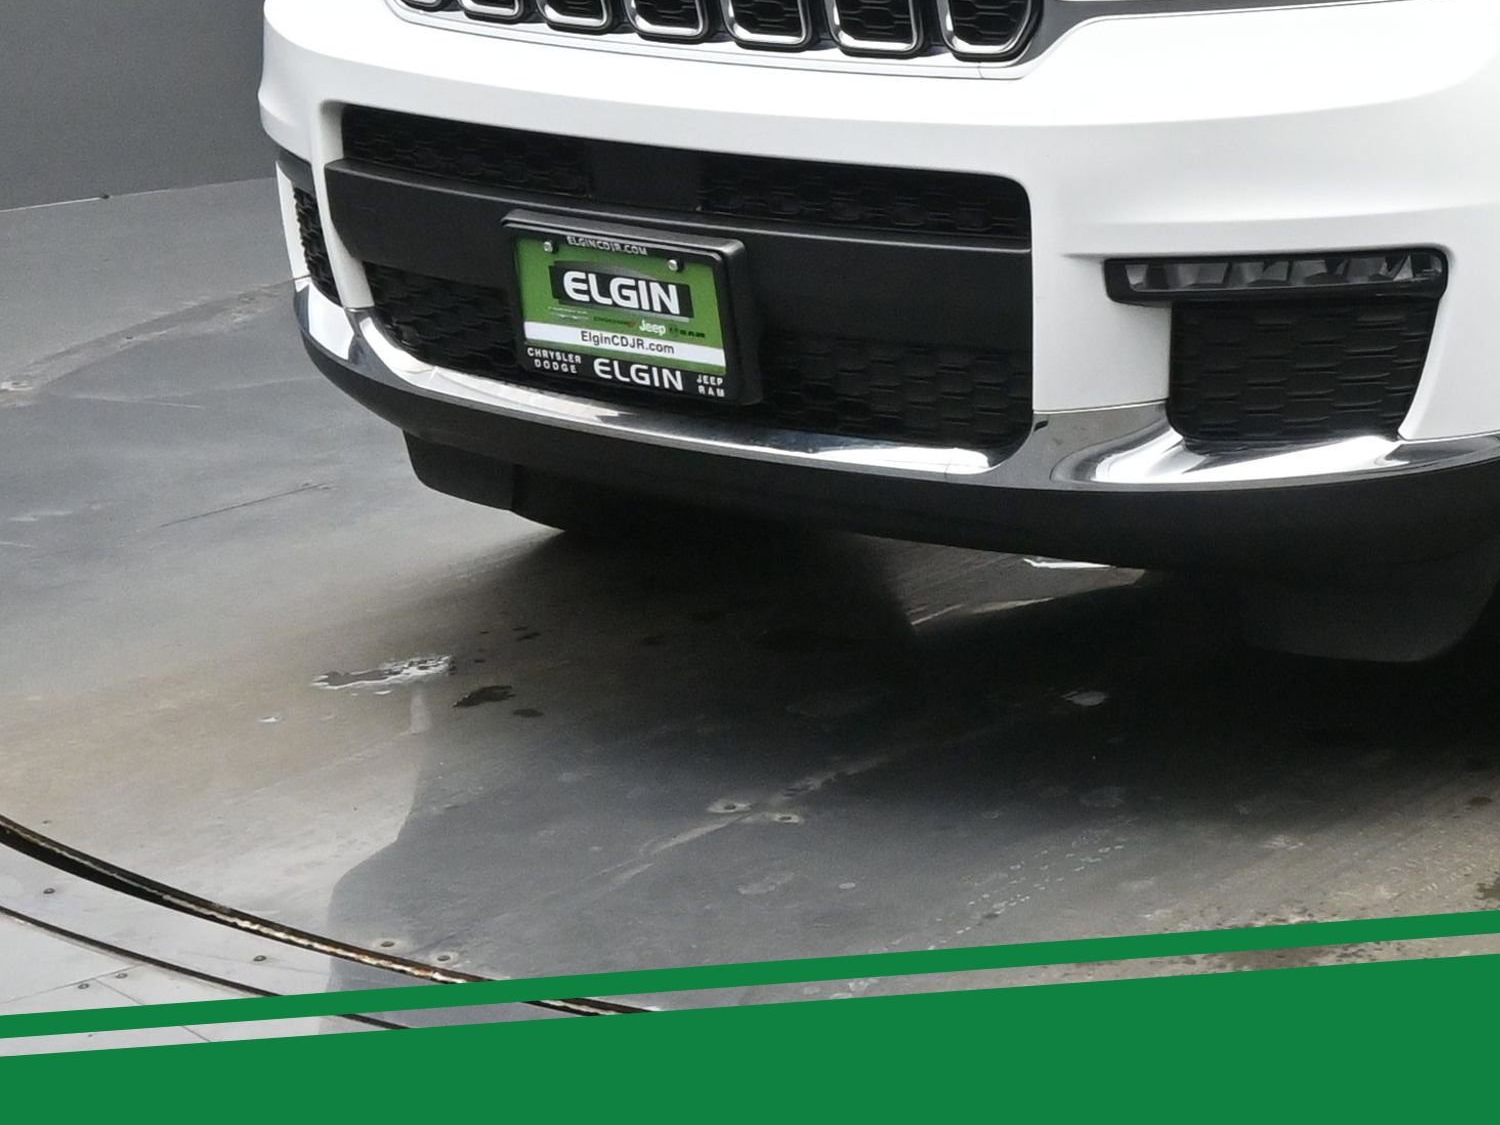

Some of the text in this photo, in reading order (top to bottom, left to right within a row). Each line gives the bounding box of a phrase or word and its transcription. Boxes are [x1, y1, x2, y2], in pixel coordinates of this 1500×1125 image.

[566, 235, 649, 256] ELGINCDJR.COM
[563, 270, 680, 315] ELGIN
[638, 318, 667, 337] Jeep
[580, 330, 676, 355] ElginCDJR.com
[527, 346, 582, 365] CHRYSLER
[534, 358, 579, 374] DODGE
[593, 358, 684, 391] ELGIN
[696, 375, 724, 386] JEEP
[698, 385, 726, 398] RAM
